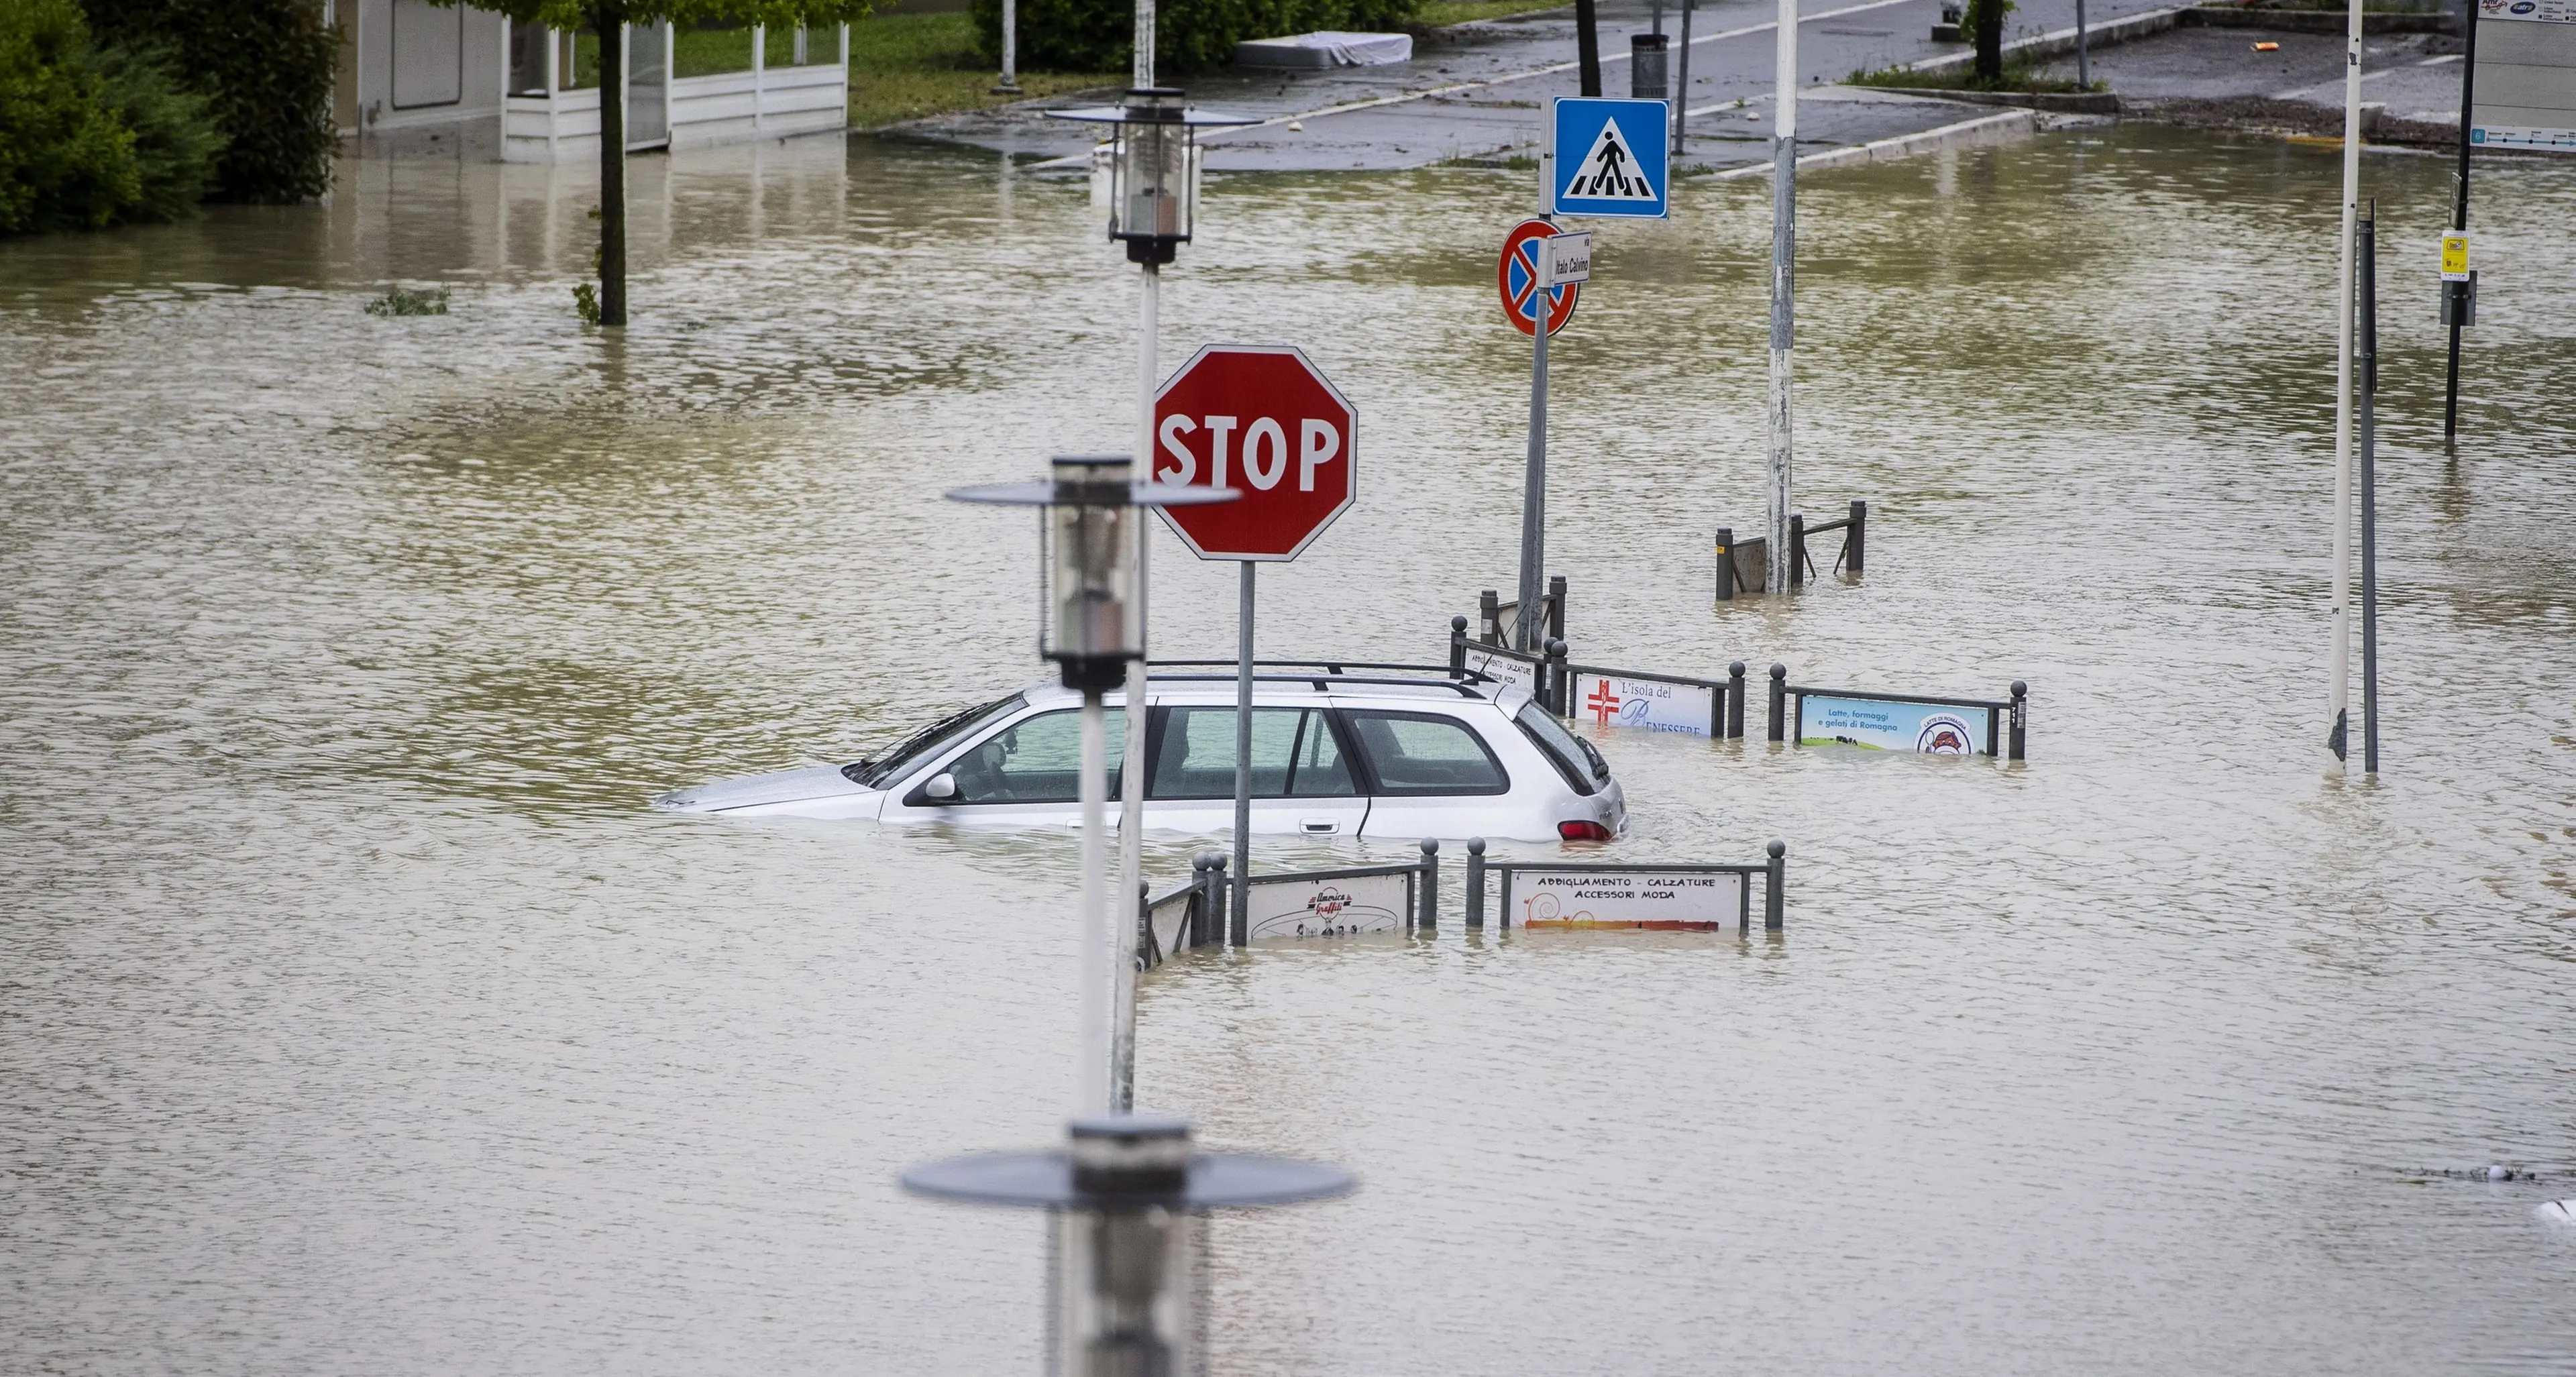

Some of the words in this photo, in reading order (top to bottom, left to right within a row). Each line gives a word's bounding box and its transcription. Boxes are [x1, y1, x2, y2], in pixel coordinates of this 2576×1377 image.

[1556, 259, 1568, 275] Italo
[1570, 257, 1589, 274] Calvino
[1158, 413, 1340, 492] STOP
[1622, 681, 1654, 697] L'isola
[1656, 685, 1671, 698] del
[1828, 709, 1849, 718] Latte,
[1852, 710, 1888, 722] formaggi
[1825, 719, 1847, 728] gelati
[1860, 721, 1898, 732] Romagna
[1924, 717, 1937, 727] LATTE
[1944, 716, 1966, 730] ROMAGNA
[1538, 878, 1631, 888] ABBIGLIAMENTO
[1317, 892, 1345, 902] America
[1574, 891, 1635, 899] ACCESSORI
[1316, 901, 1343, 915] Graffiti
